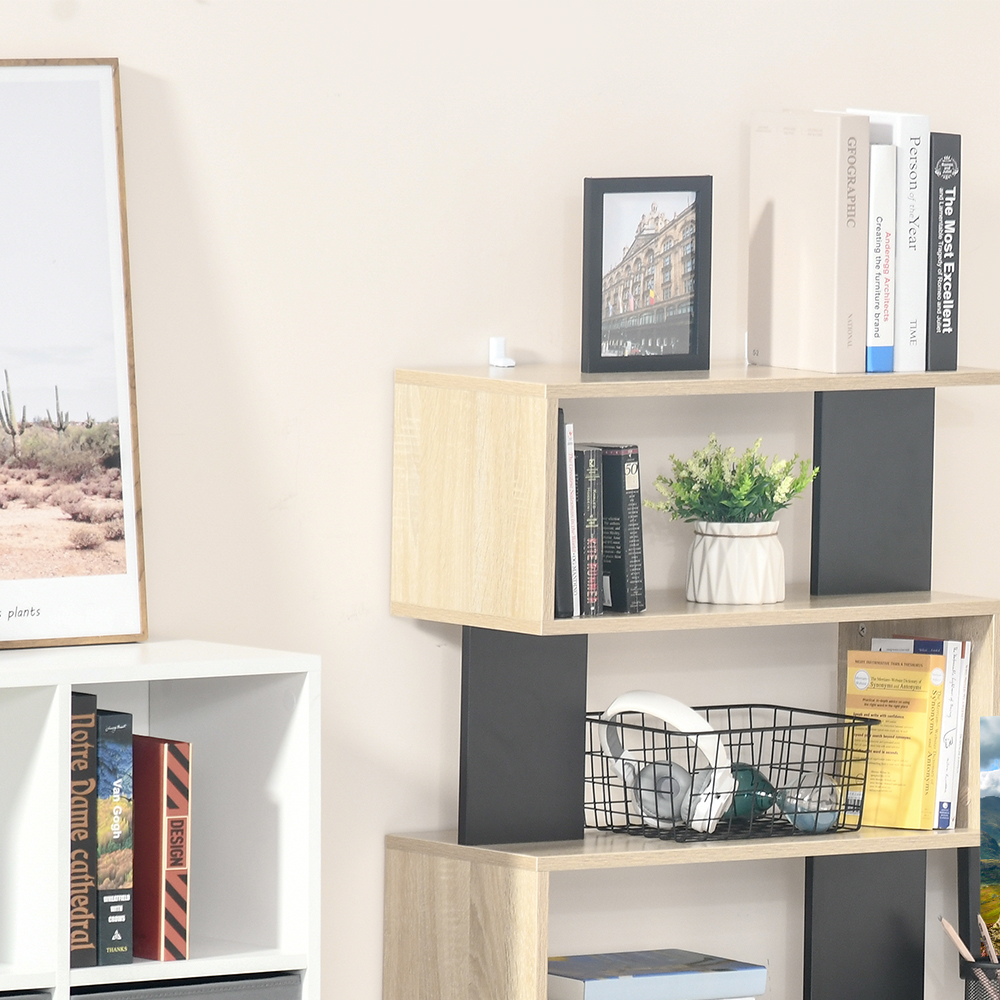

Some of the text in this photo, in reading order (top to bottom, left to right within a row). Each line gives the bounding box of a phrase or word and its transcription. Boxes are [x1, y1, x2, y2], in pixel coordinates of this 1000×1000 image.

[909, 136, 921, 190] Person
[874, 216, 883, 254] Creating
[908, 216, 920, 251] Year
[936, 241, 944, 267] Tragedy
[942, 186, 956, 334] The Most Excellent
[874, 273, 882, 310] furniture
[883, 232, 892, 322] Anderegg Architects
[873, 313, 881, 338] brand
[909, 319, 918, 346] TIME
[8, 606, 41, 621] plants
[870, 681, 893, 690] Synonyms
[900, 683, 922, 691] Antonyms
[928, 689, 938, 735] Synonyms
[924, 751, 933, 796] Antonyms
[112, 779, 124, 840] Van Gogh
[71, 712, 96, 951] Notre Dame cathedral
[170, 819, 185, 868] DESIGN
[106, 945, 128, 953] THANKS
